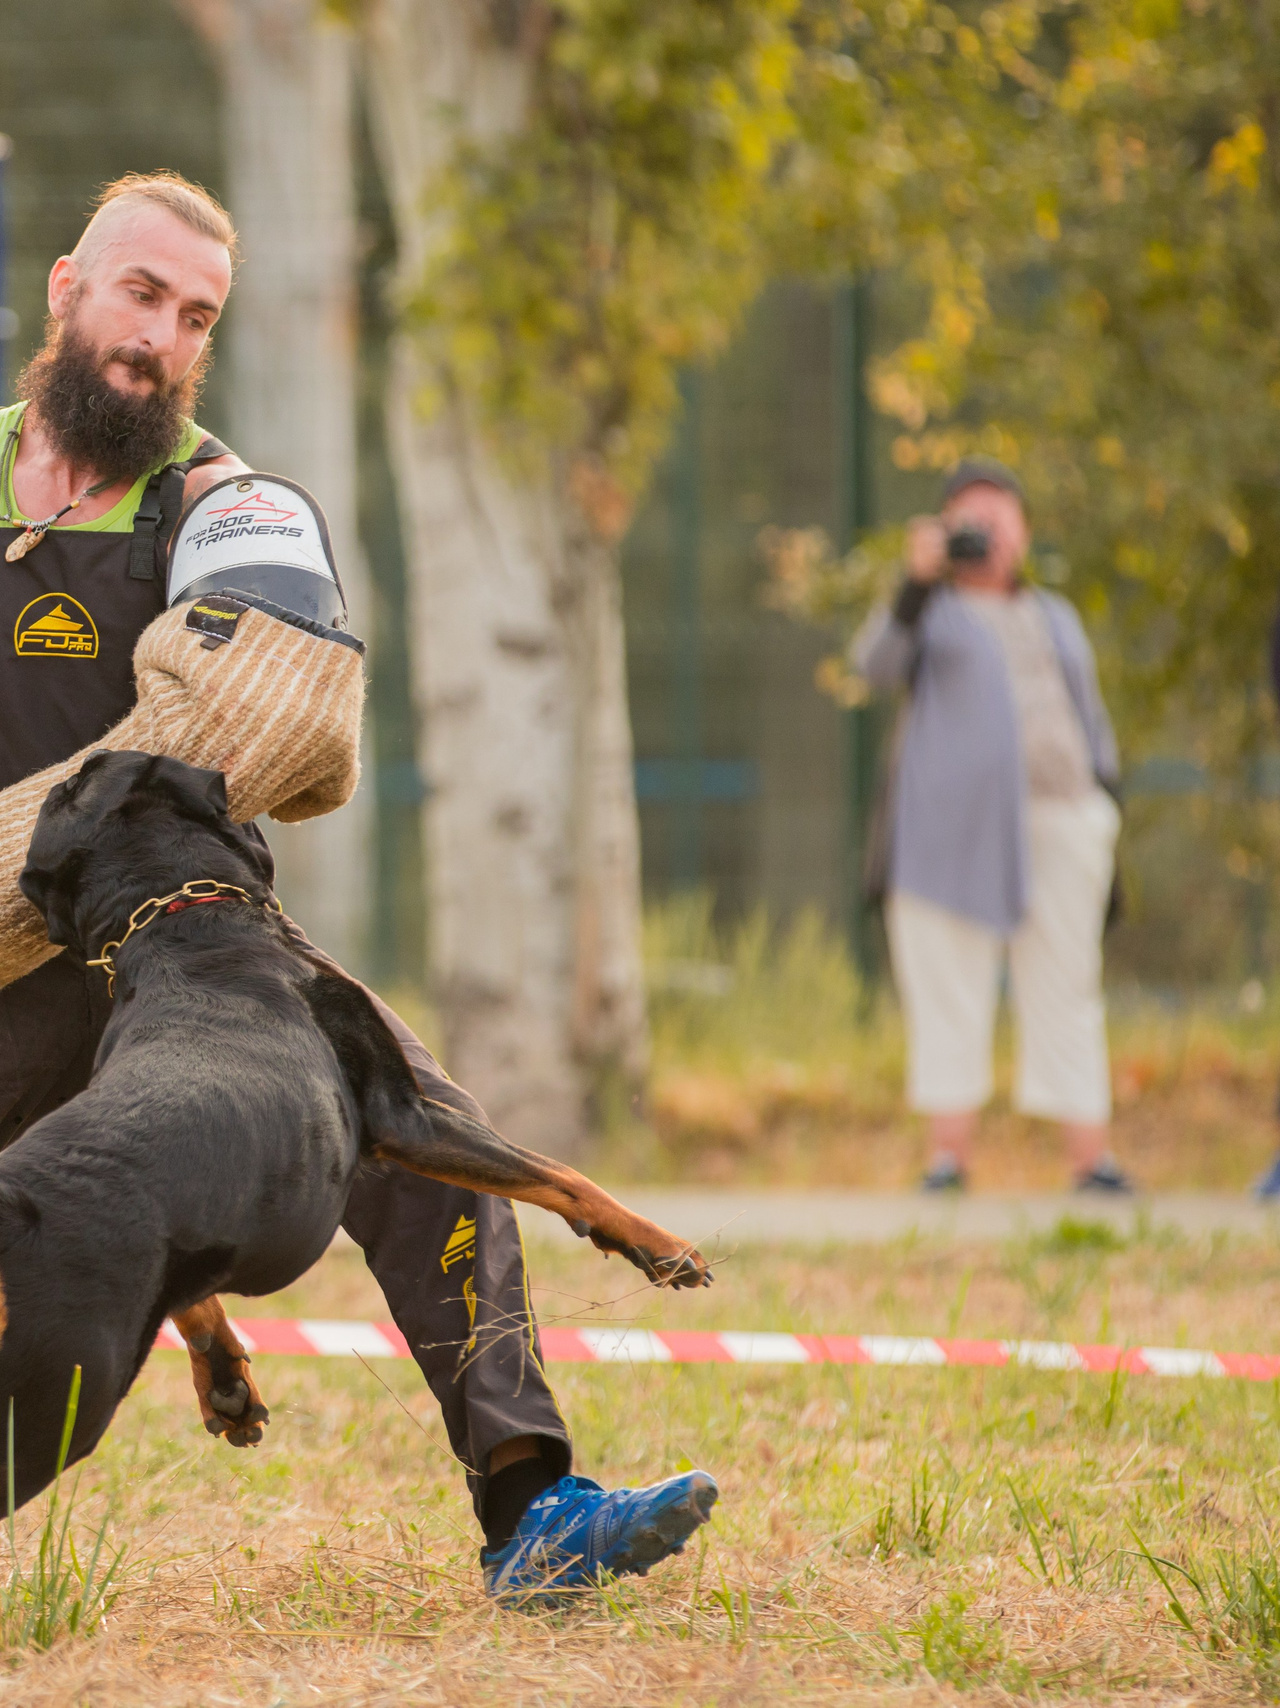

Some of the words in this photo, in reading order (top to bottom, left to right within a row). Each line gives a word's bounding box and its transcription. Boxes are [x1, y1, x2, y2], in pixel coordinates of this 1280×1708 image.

[186, 529, 207, 545] FOR
[208, 514, 255, 533] DOG
[195, 525, 305, 550] TRAINERS
